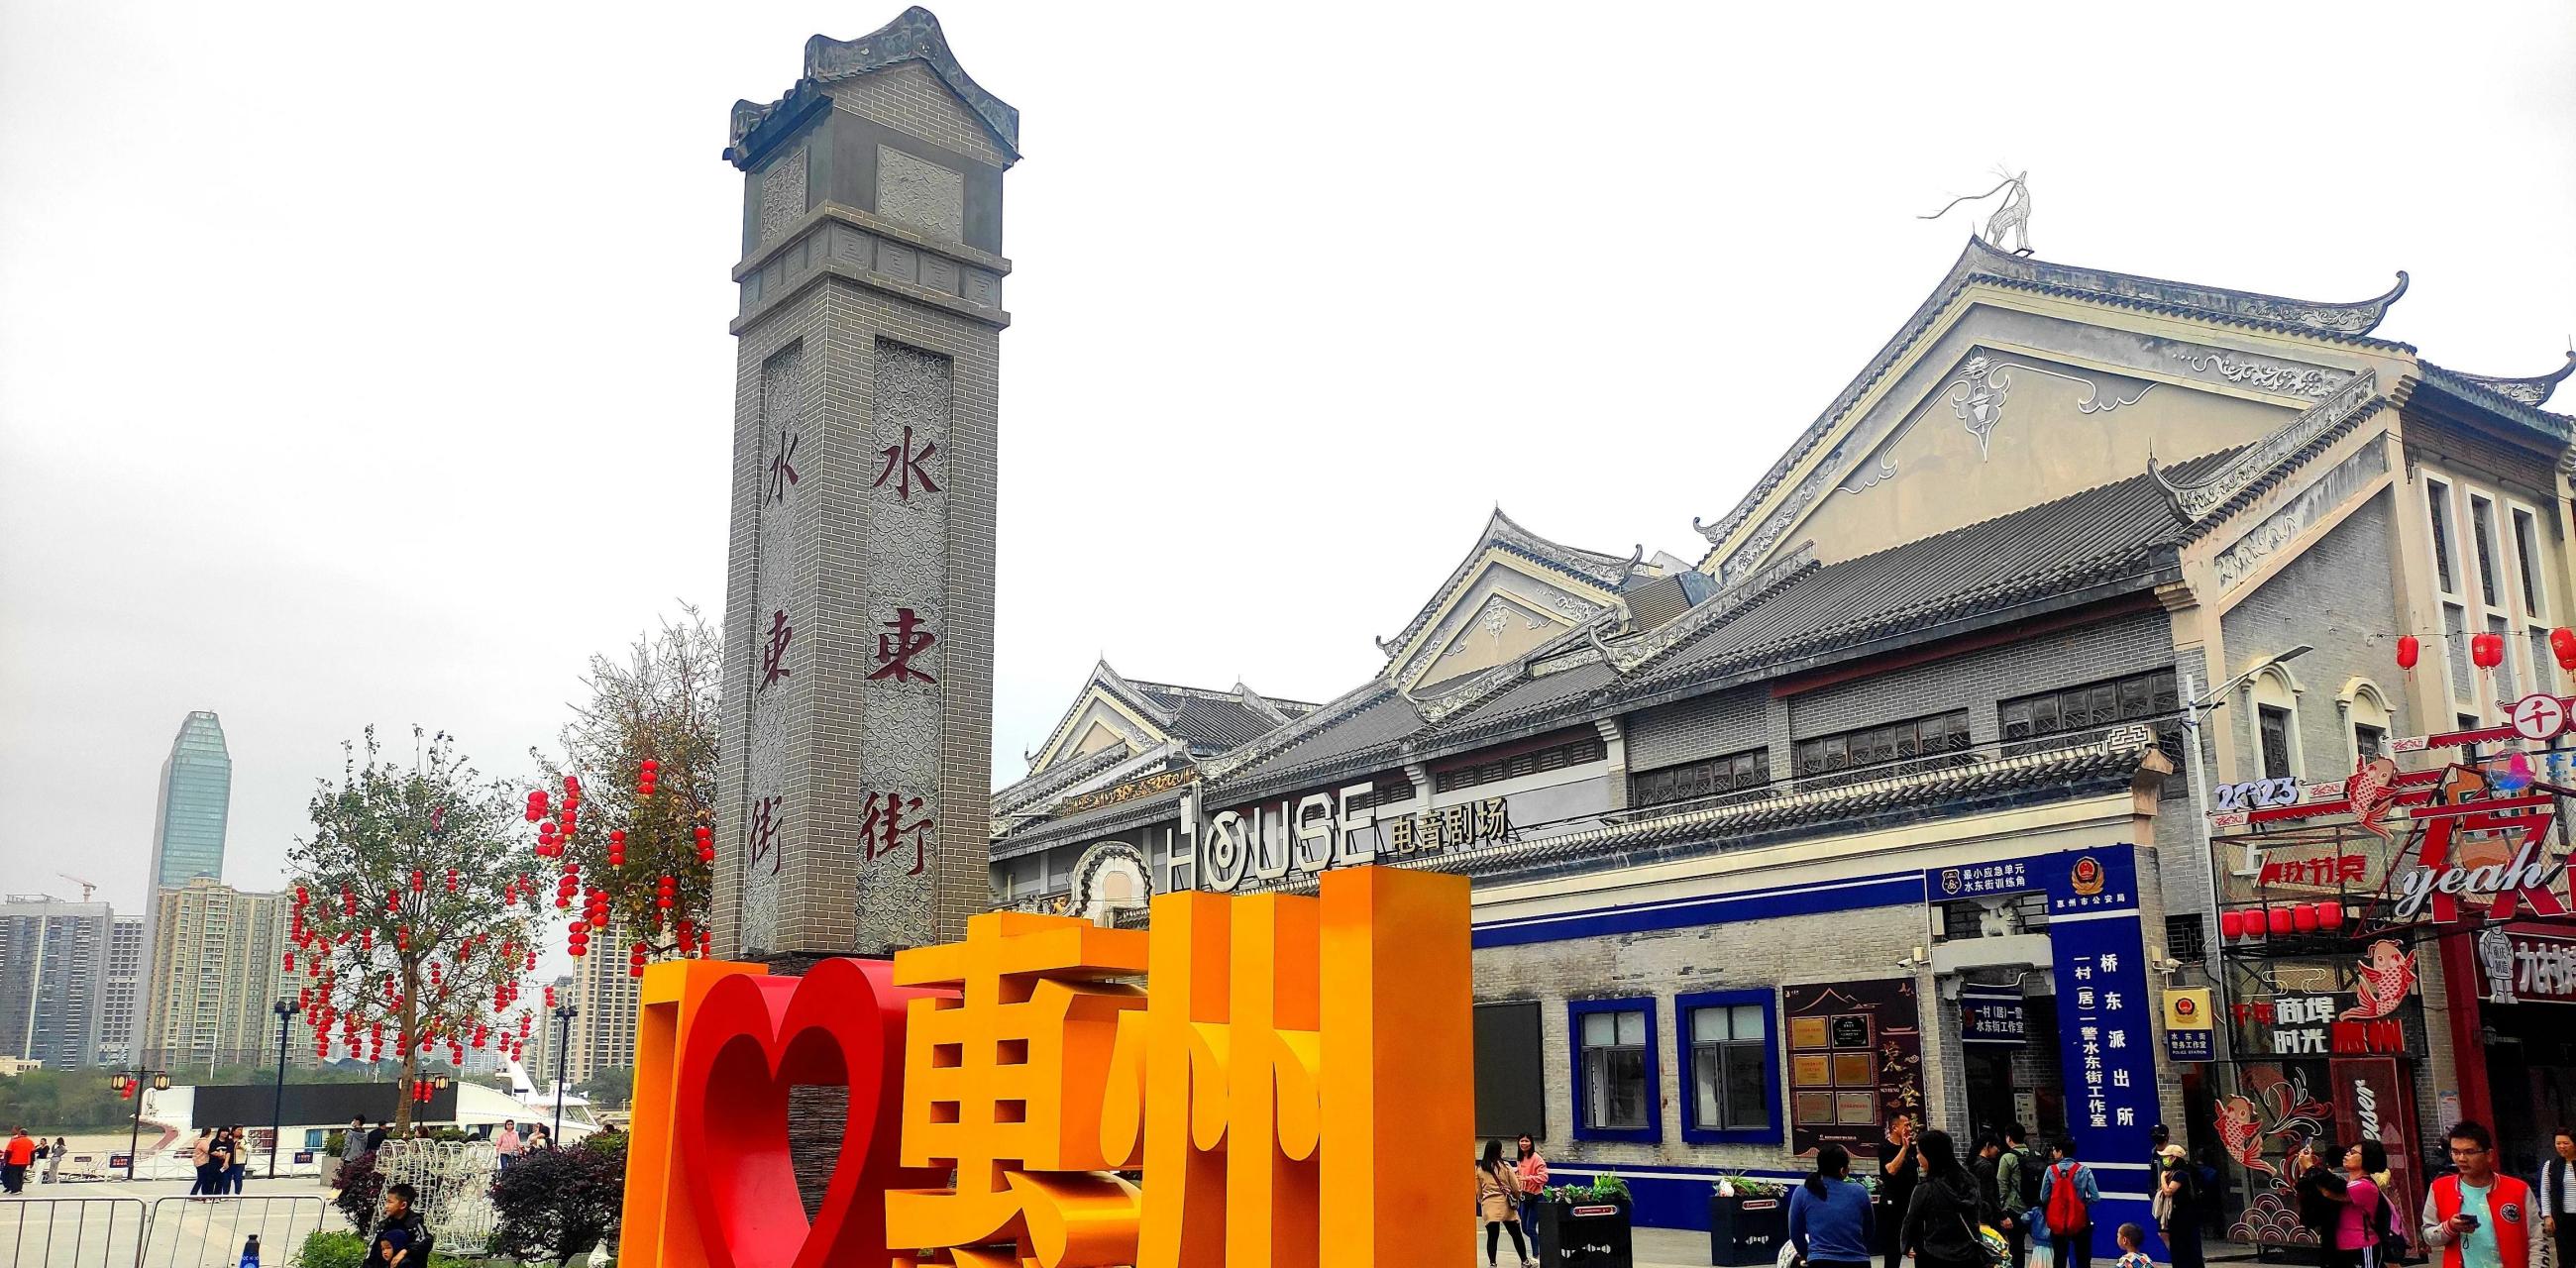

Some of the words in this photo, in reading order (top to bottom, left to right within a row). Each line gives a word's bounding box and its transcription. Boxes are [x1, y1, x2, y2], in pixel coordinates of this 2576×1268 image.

[2520, 699, 2557, 733] 千
[2213, 777, 2299, 810] 2023
[1167, 781, 1375, 894] HOUSE
[1391, 797, 1506, 854] 电音剧场
[1964, 863, 2025, 880] 最小应急单元
[1964, 876, 2025, 893] 水东街训练角
[2395, 840, 2563, 917] yeah
[2056, 893, 2125, 908] 惠州市公安局
[1975, 1004, 2023, 1019] 一村(居)一警
[1976, 1019, 2024, 1033] 水东街工作室
[2074, 956, 2107, 1127] 一村(居)一警水东街工作室
[2099, 953, 2134, 1126] 桥东派出所
